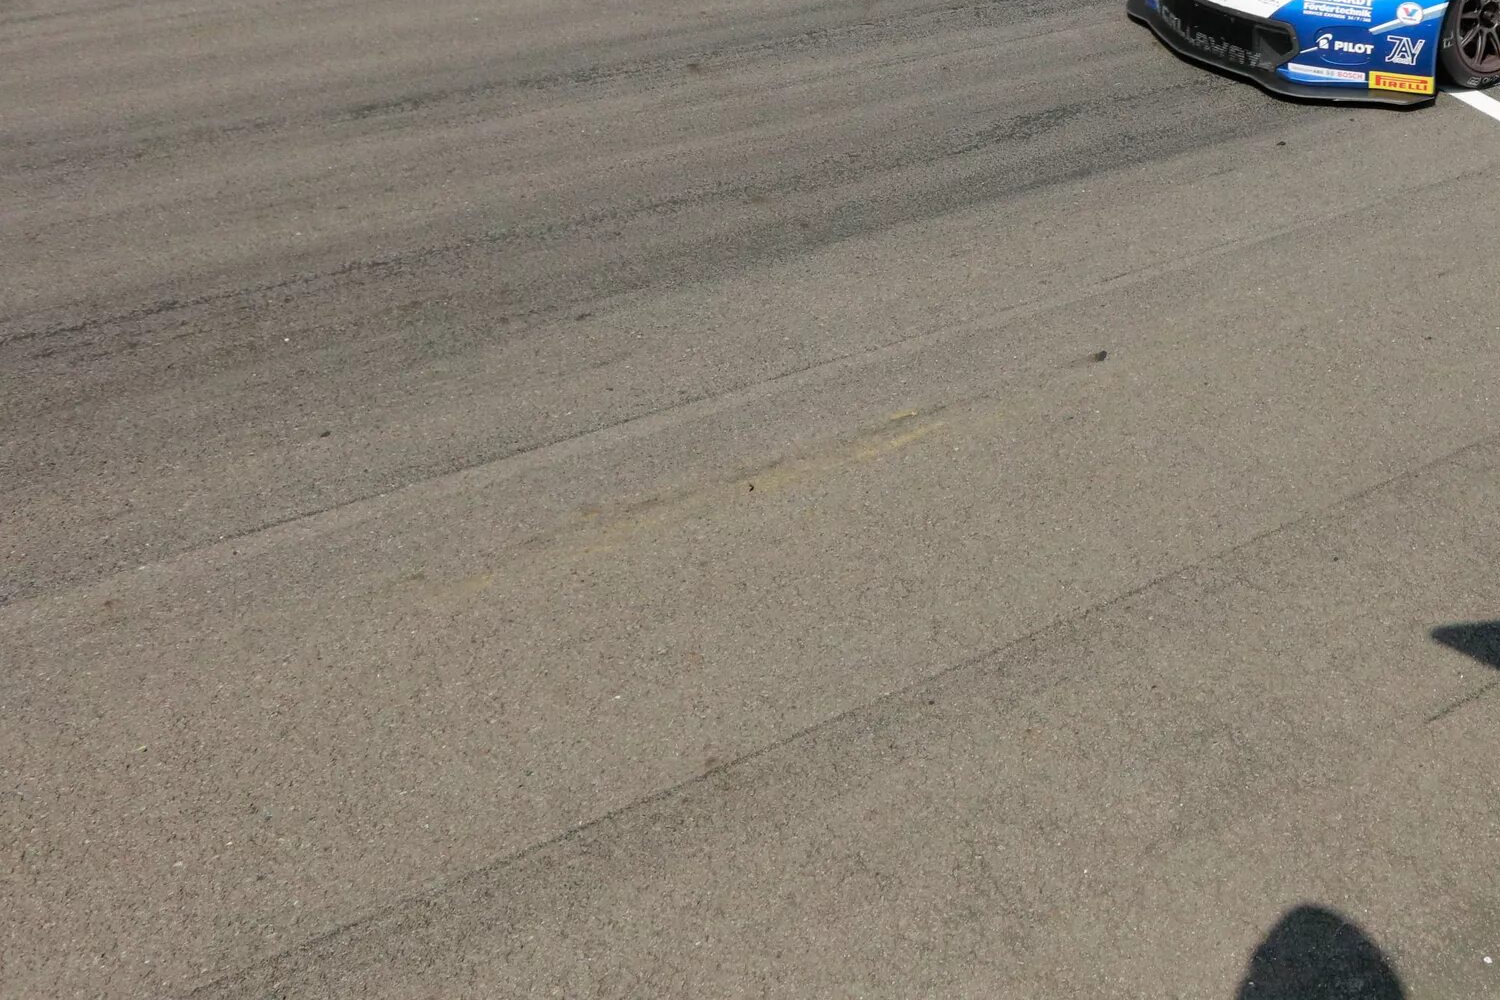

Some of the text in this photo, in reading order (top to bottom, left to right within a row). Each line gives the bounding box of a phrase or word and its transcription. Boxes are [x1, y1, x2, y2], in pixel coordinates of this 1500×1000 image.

[1303, 2, 1372, 17] Fördertechnik
[1334, 41, 1374, 54] PILOT
[1337, 71, 1363, 80] BOSCH
[1375, 74, 1428, 91] PIRELLI
